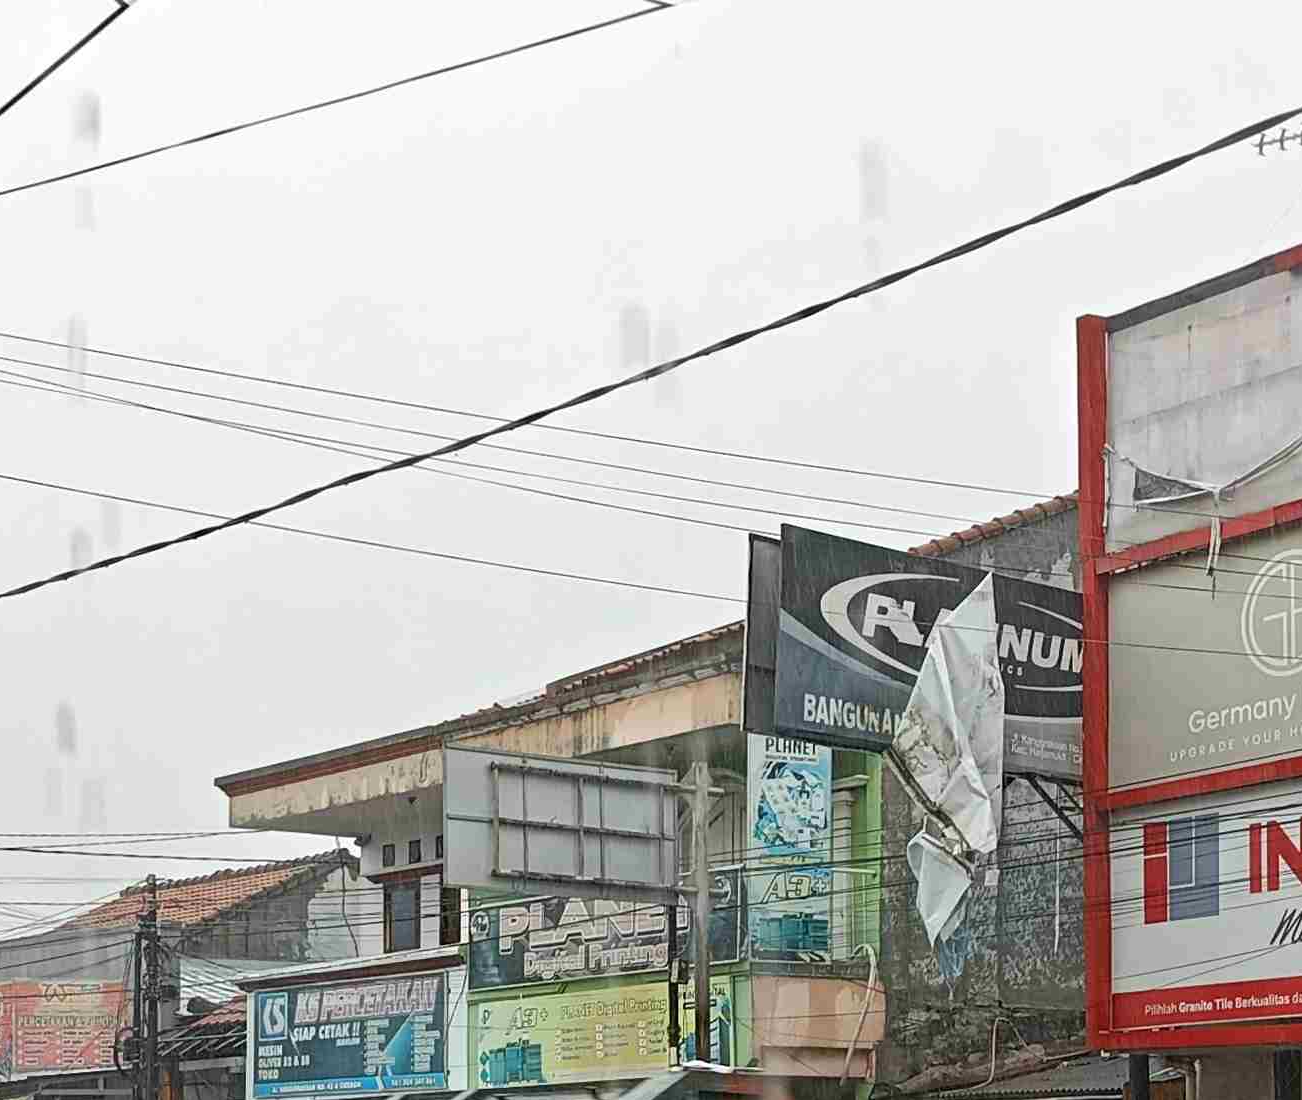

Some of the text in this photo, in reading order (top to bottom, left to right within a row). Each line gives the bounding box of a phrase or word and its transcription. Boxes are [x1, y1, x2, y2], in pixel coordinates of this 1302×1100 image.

[1187, 692, 1298, 735] Germany
[1169, 738, 1236, 762] UPGRADE
[1242, 728, 1282, 746] YOUR
[1213, 998, 1234, 1011] Tile
[1235, 995, 1290, 1009] Berkualitas
